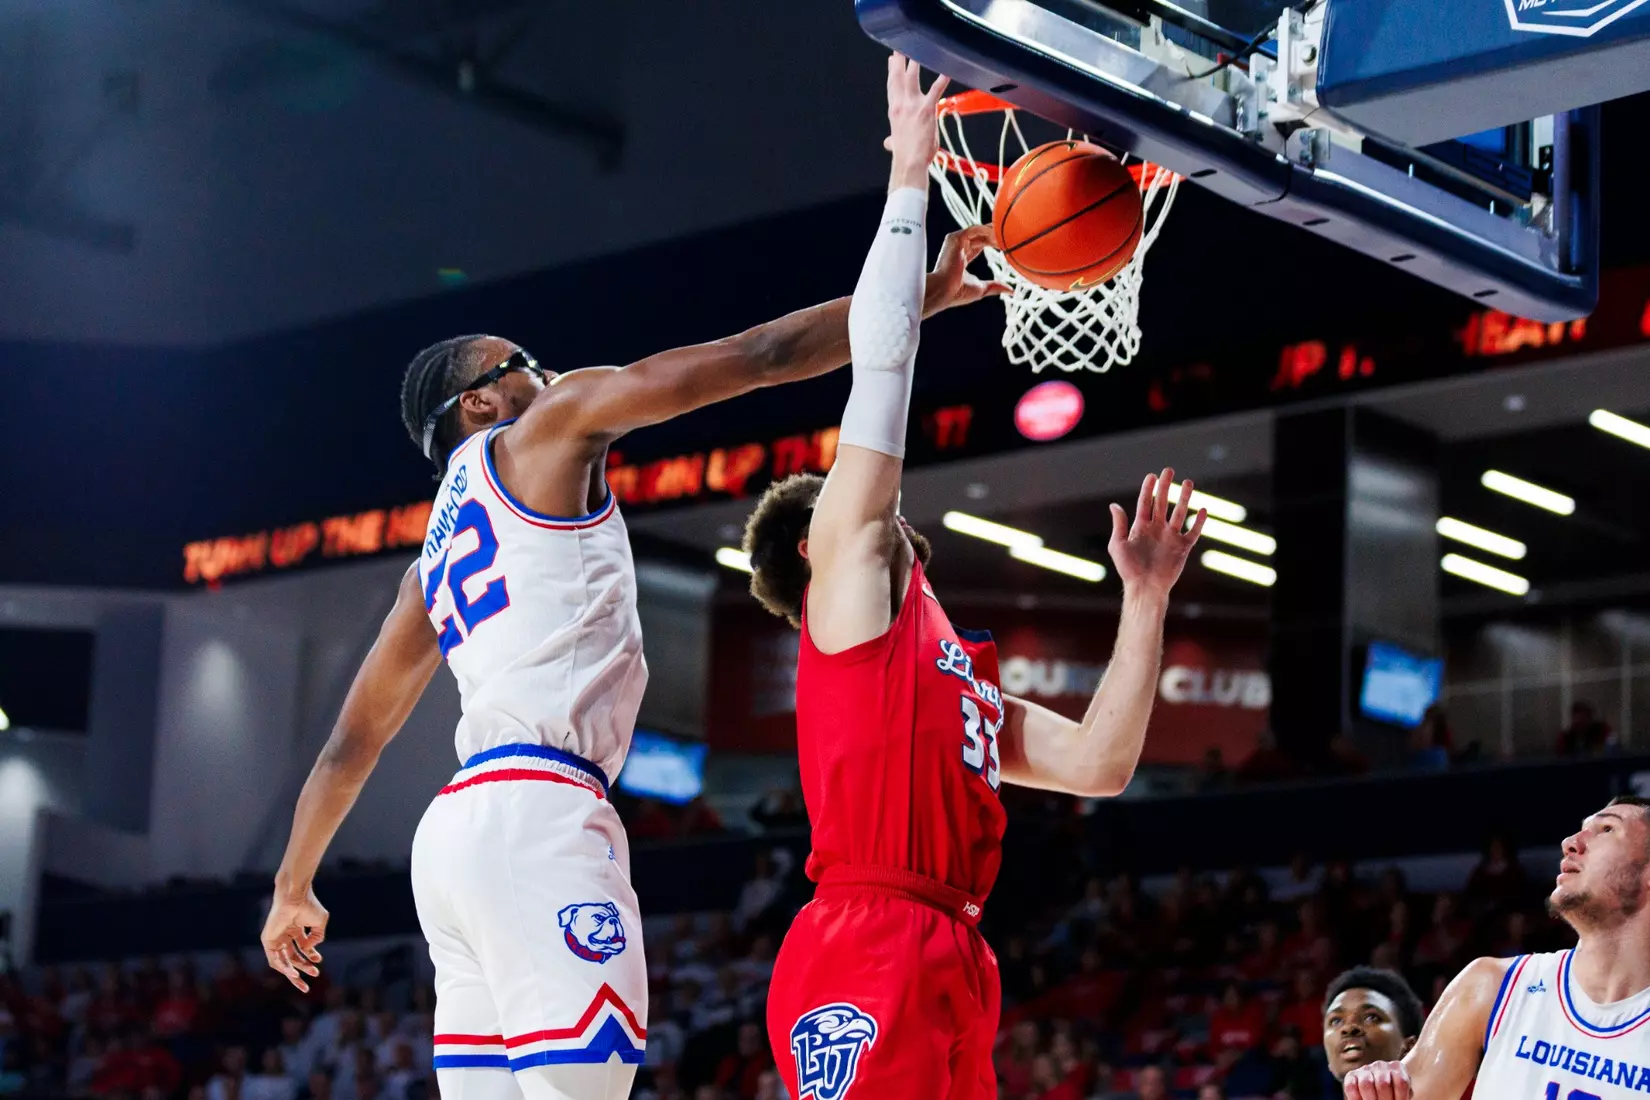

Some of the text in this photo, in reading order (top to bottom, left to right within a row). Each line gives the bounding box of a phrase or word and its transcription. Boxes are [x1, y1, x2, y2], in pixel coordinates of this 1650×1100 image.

[424, 497, 510, 664] 22
[1160, 665, 1272, 709] CLUB
[960, 694, 1001, 793] 33
[1515, 1035, 1650, 1095] LOUISIANA
